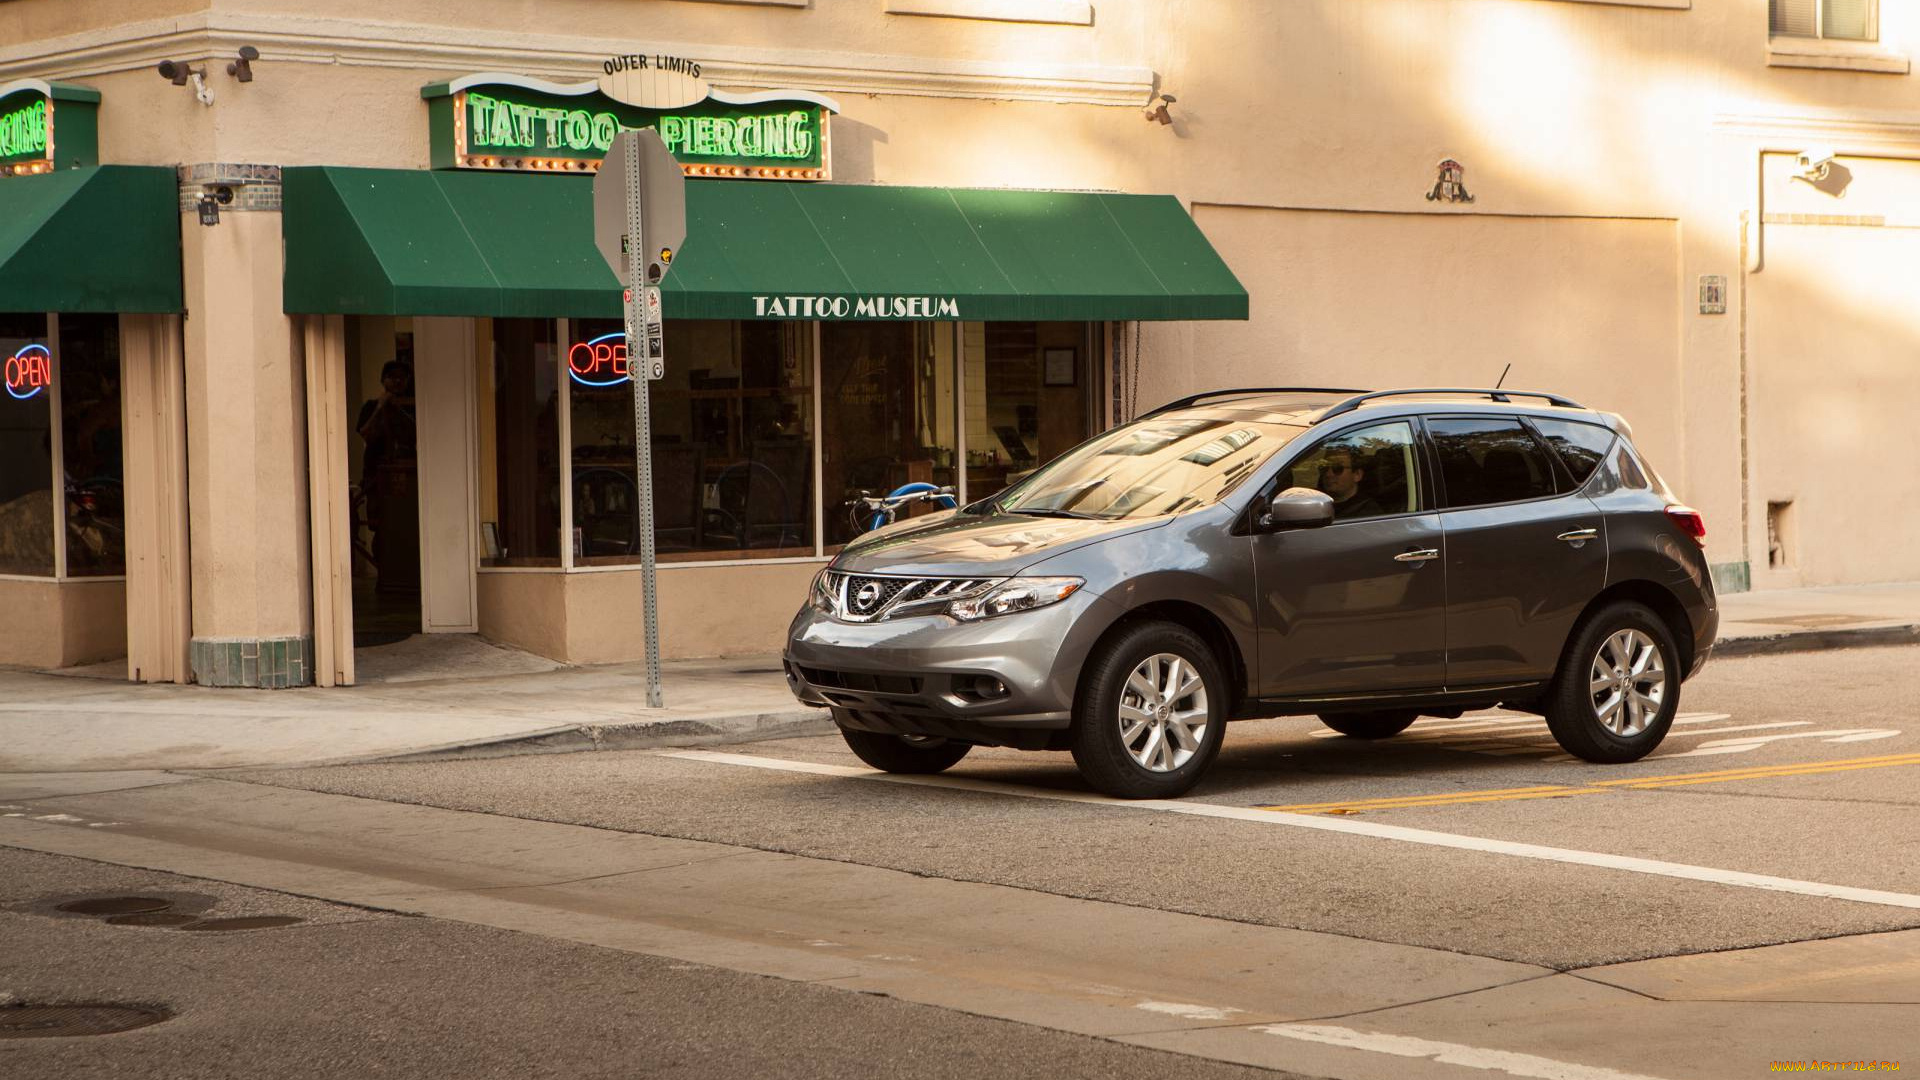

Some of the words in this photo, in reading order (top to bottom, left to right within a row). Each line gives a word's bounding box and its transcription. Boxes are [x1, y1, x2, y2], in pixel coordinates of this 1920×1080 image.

[604, 55, 649, 76] OUTER
[656, 55, 701, 78] LIMITS
[0, 100, 47, 156] CING
[467, 93, 620, 151] TATTOO
[660, 111, 812, 158] PIERCING
[752, 296, 850, 317] TATTOO
[854, 297, 960, 317] MUSEUM
[6, 356, 51, 387] OPEN
[569, 343, 627, 373] OPE
